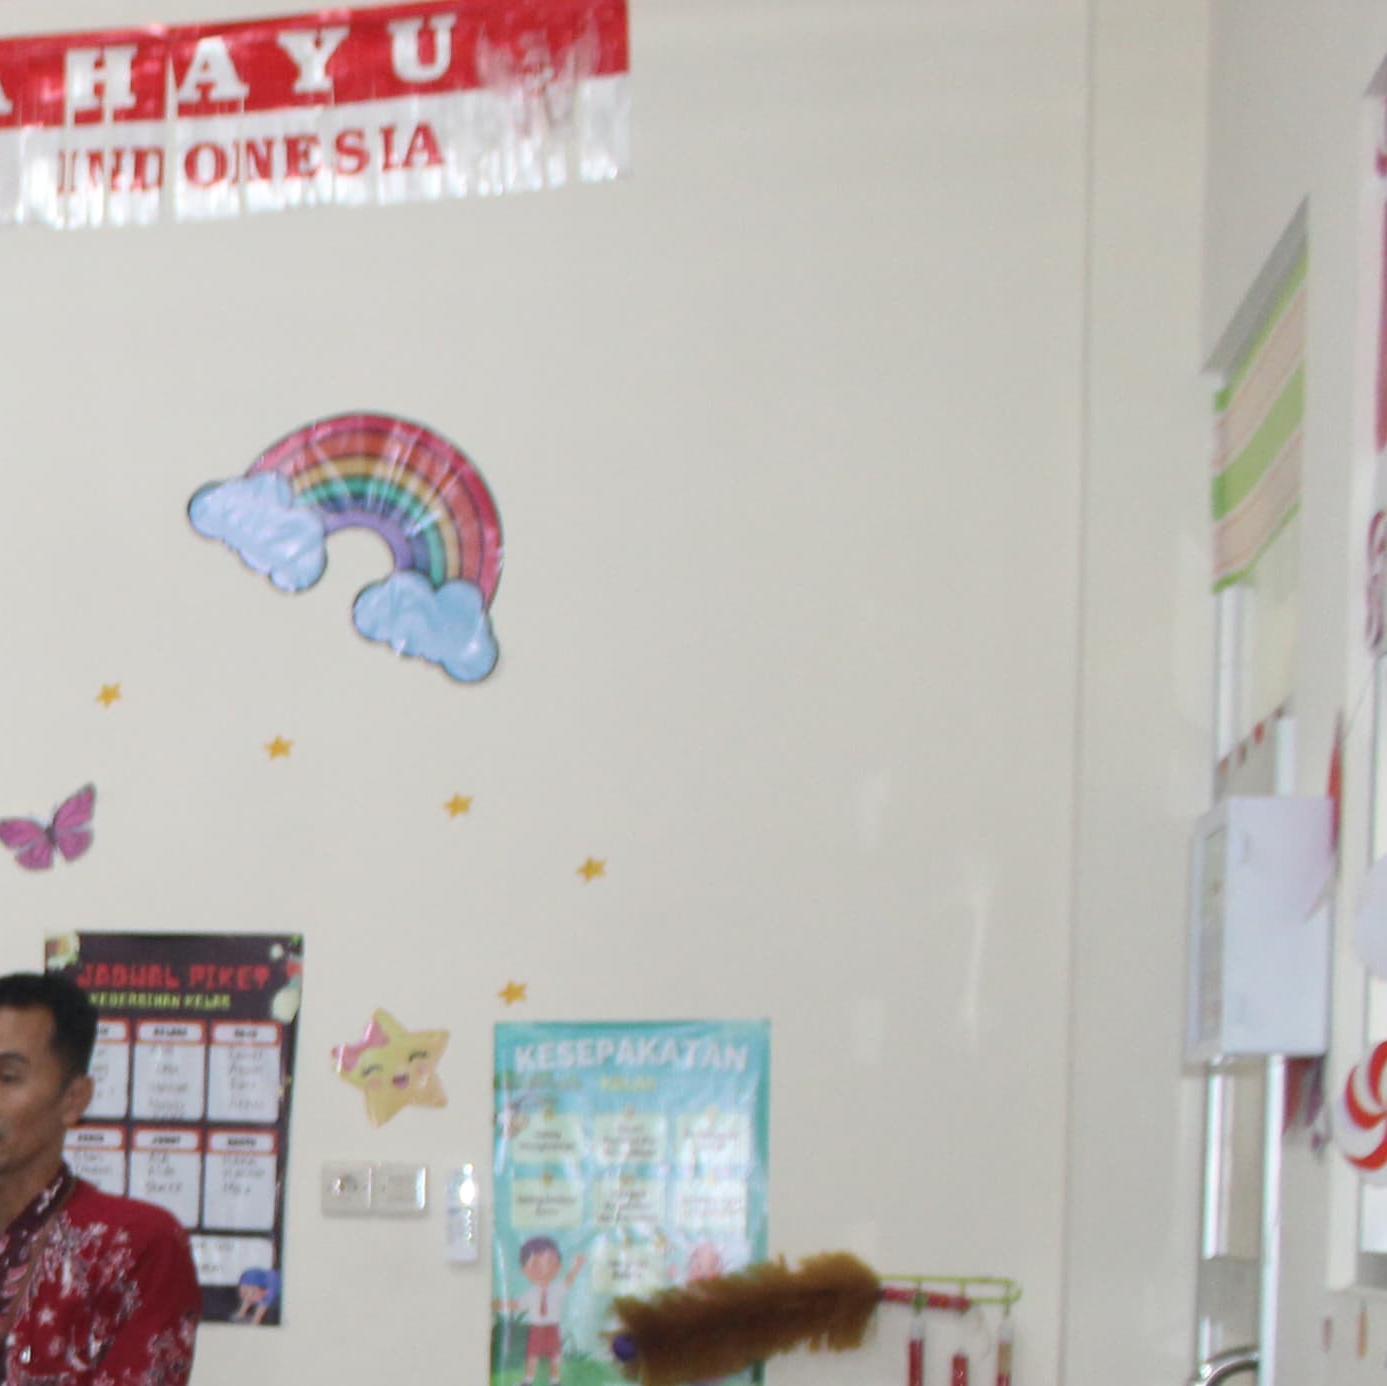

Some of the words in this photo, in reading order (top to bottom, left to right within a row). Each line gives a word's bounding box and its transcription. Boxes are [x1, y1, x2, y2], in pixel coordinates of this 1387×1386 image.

[57, 119, 445, 195] INDONESIA
[77, 962, 180, 989] JADWAL
[187, 963, 270, 991] PIKET
[513, 1037, 749, 1073] KESEPAKATAN
